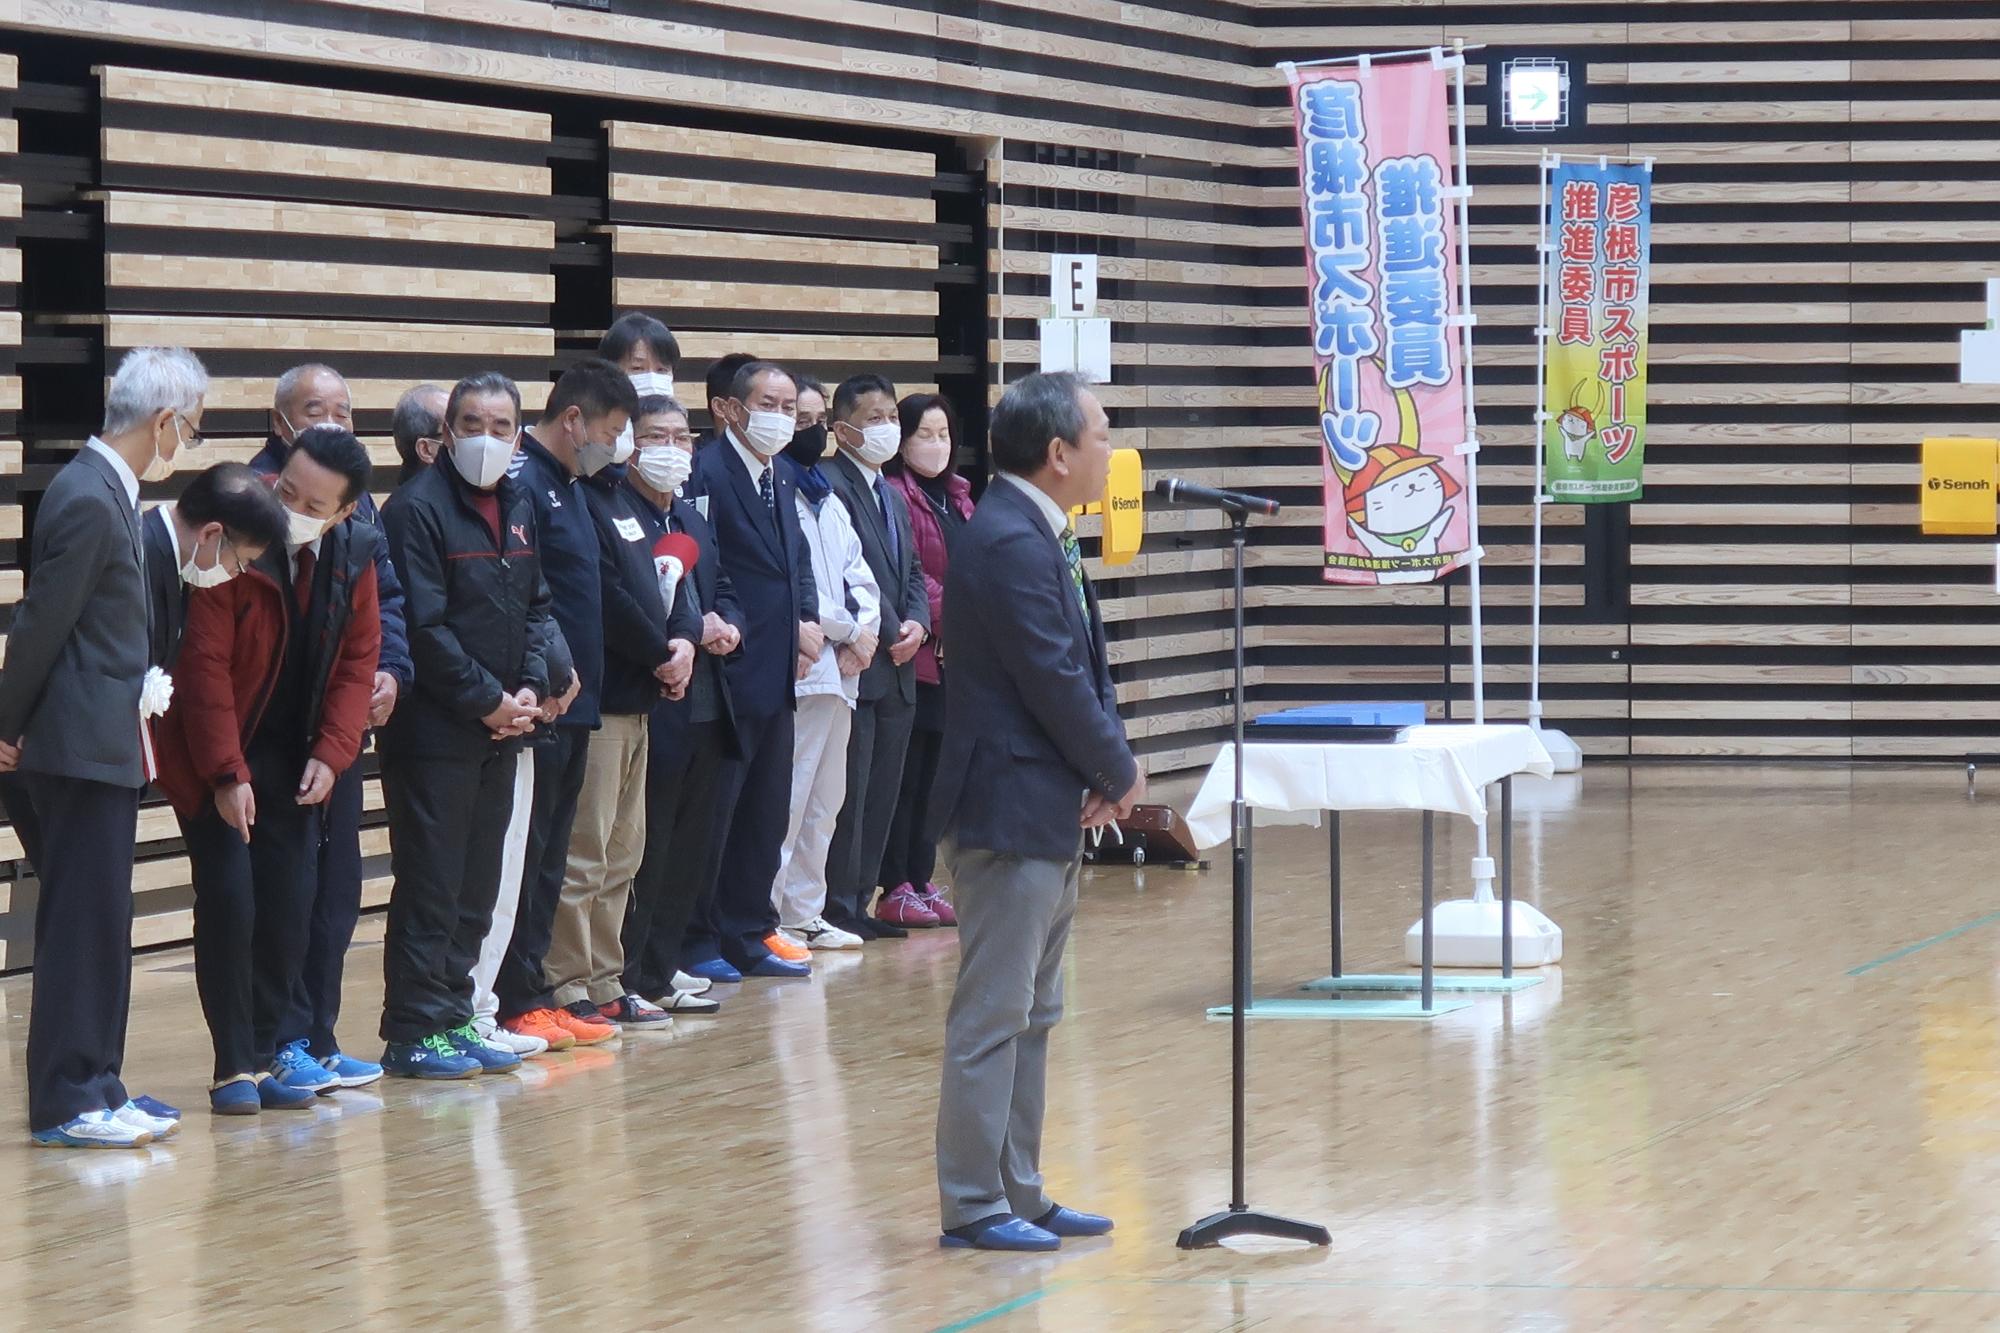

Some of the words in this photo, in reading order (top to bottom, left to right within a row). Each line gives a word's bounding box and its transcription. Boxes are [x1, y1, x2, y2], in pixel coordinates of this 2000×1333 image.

[1071, 261, 1084, 311] E
[1559, 182, 1598, 344] 推進委員
[1601, 183, 1641, 463] 彦根市スポーツ
[1118, 497, 1140, 511] Senoh
[1942, 479, 1990, 490] Senoh
